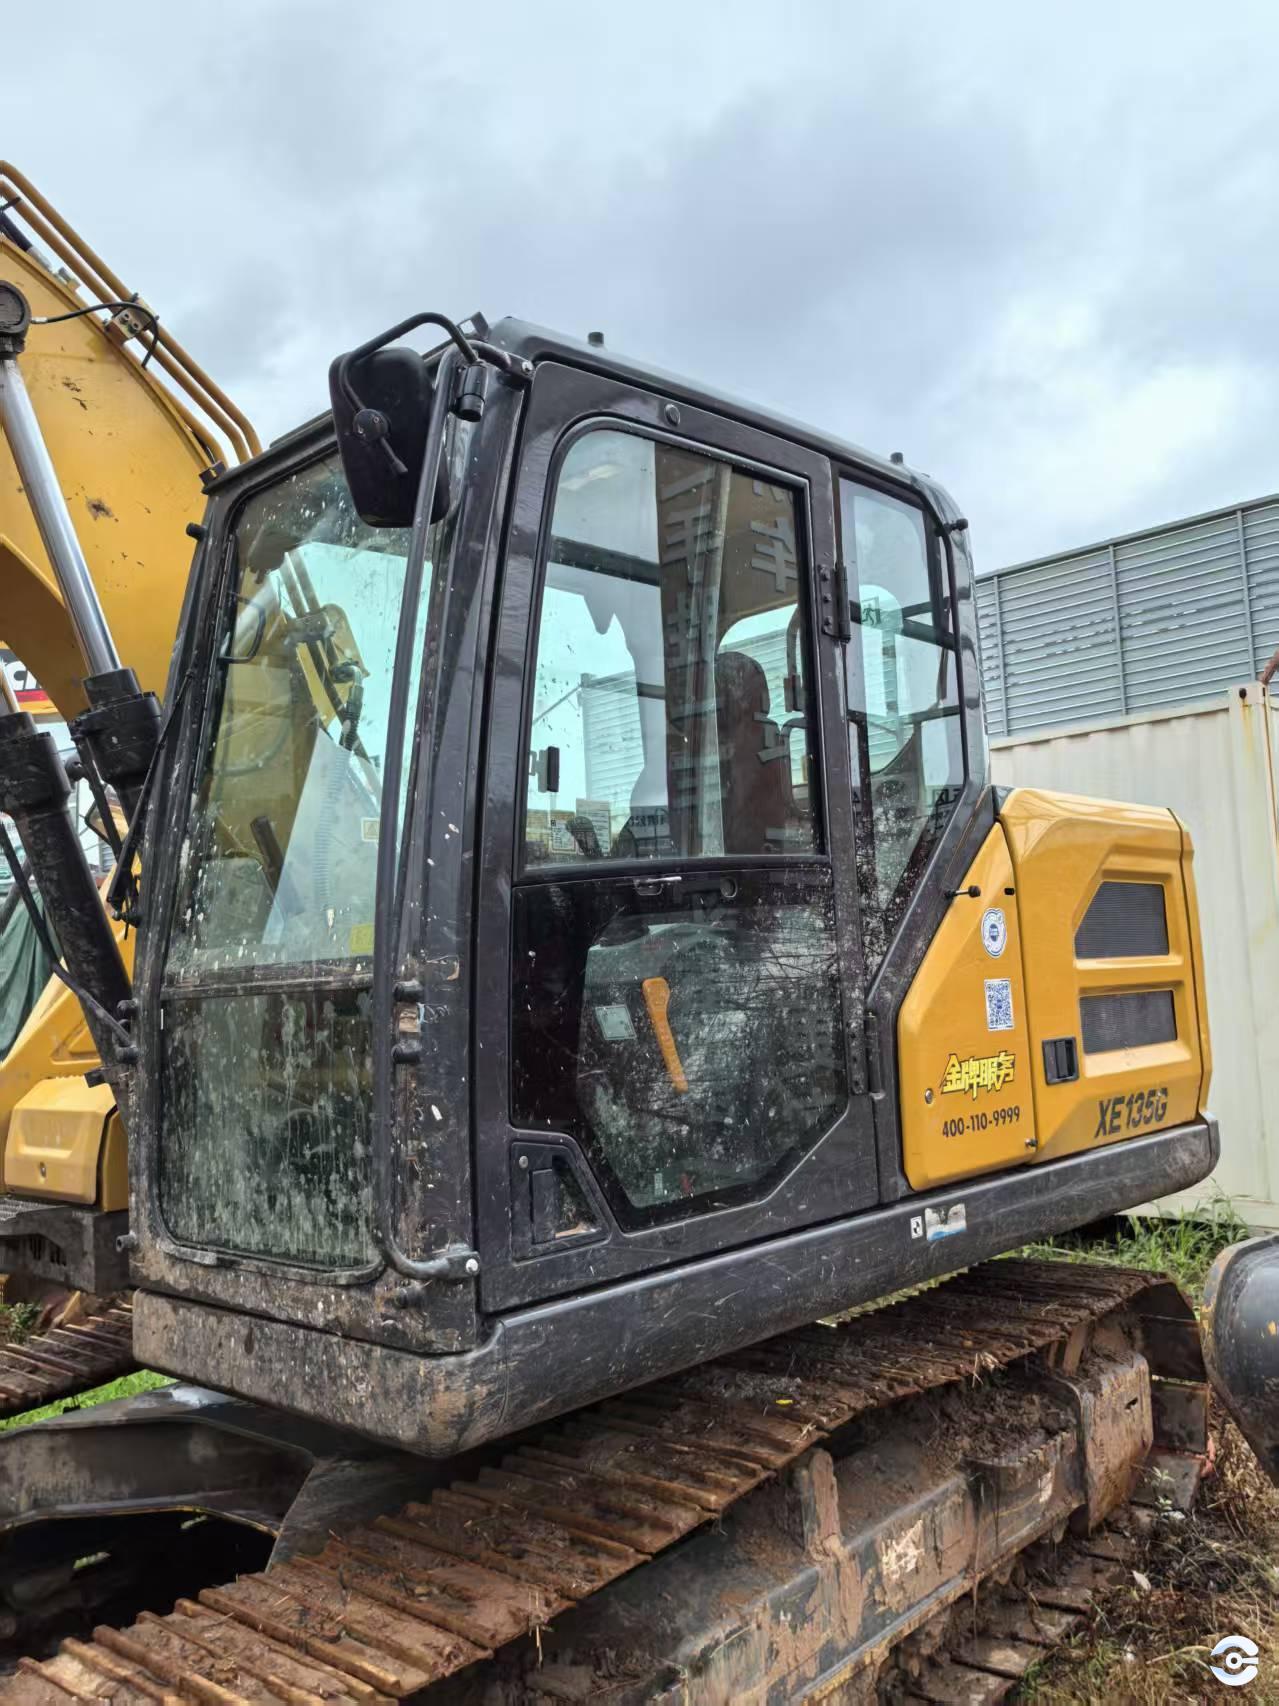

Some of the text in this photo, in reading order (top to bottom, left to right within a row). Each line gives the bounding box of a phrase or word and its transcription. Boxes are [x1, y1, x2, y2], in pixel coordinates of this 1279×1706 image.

[941, 1051, 1016, 1100] 金牌服务
[942, 1105, 1020, 1138] 400-110-9999
[1094, 1087, 1169, 1138] XE135G
